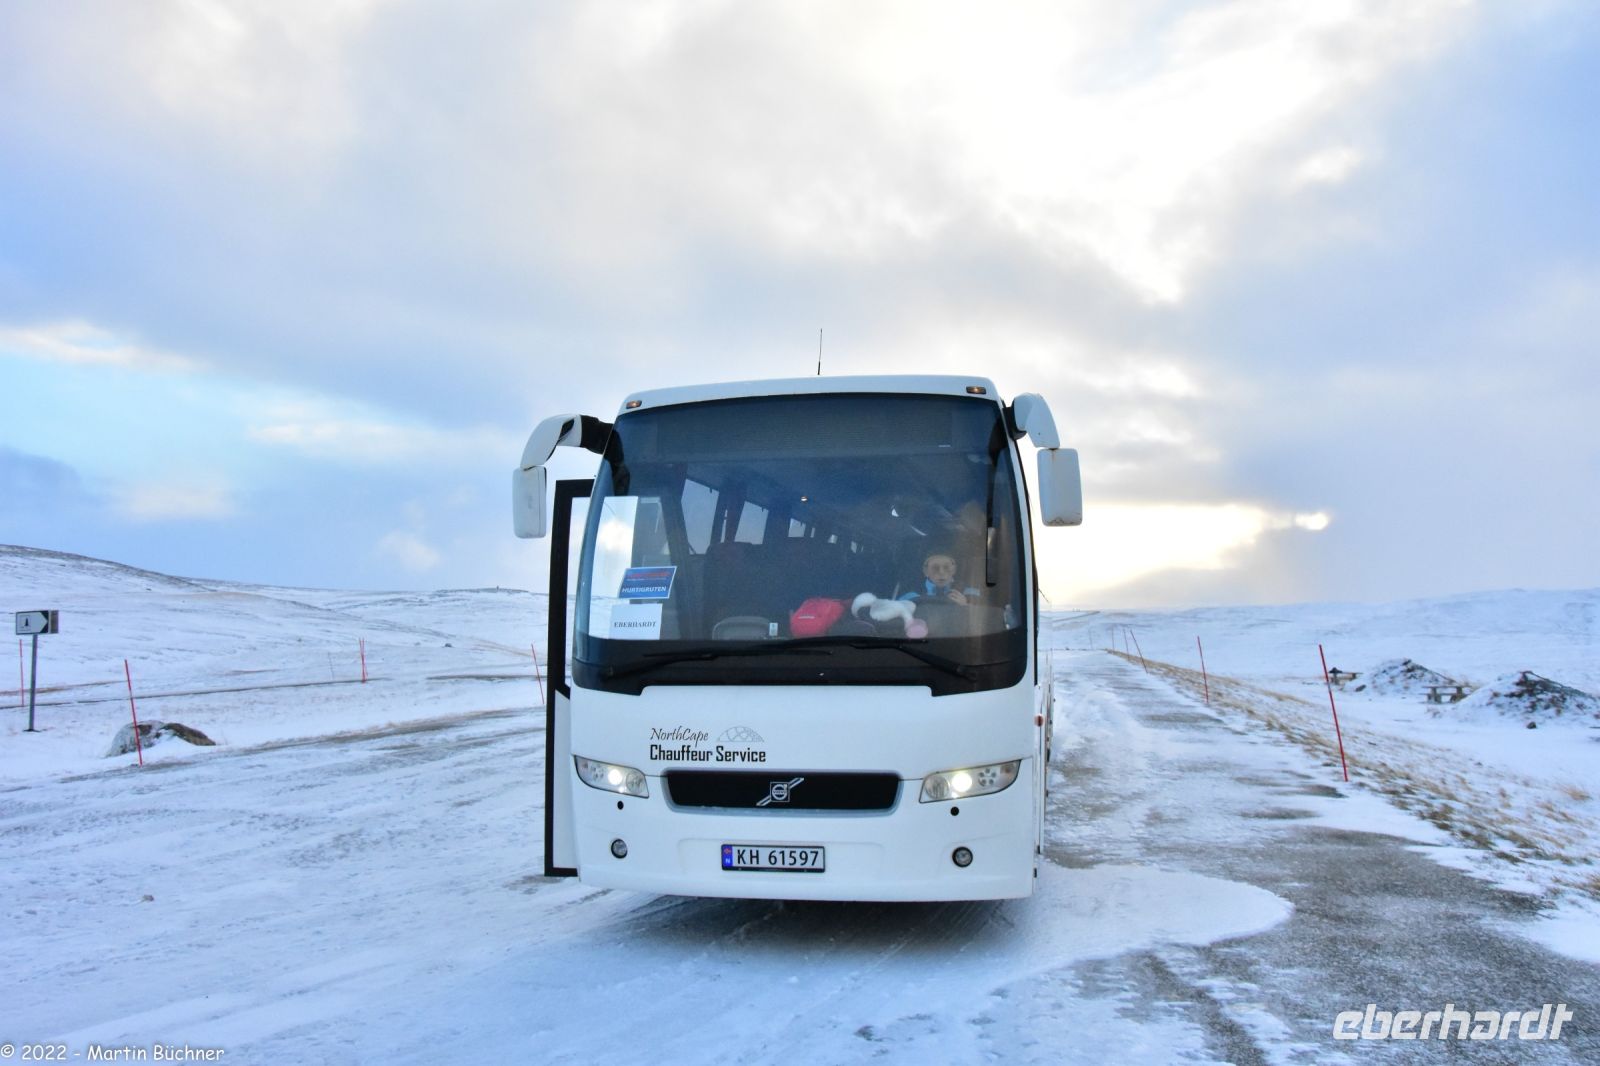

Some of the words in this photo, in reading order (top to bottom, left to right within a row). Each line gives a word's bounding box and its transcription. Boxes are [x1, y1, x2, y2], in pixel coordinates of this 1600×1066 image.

[650, 744, 713, 761] Chauffeur
[716, 745, 766, 762] Service
[737, 849, 760, 865] KH
[768, 850, 819, 867] 61597
